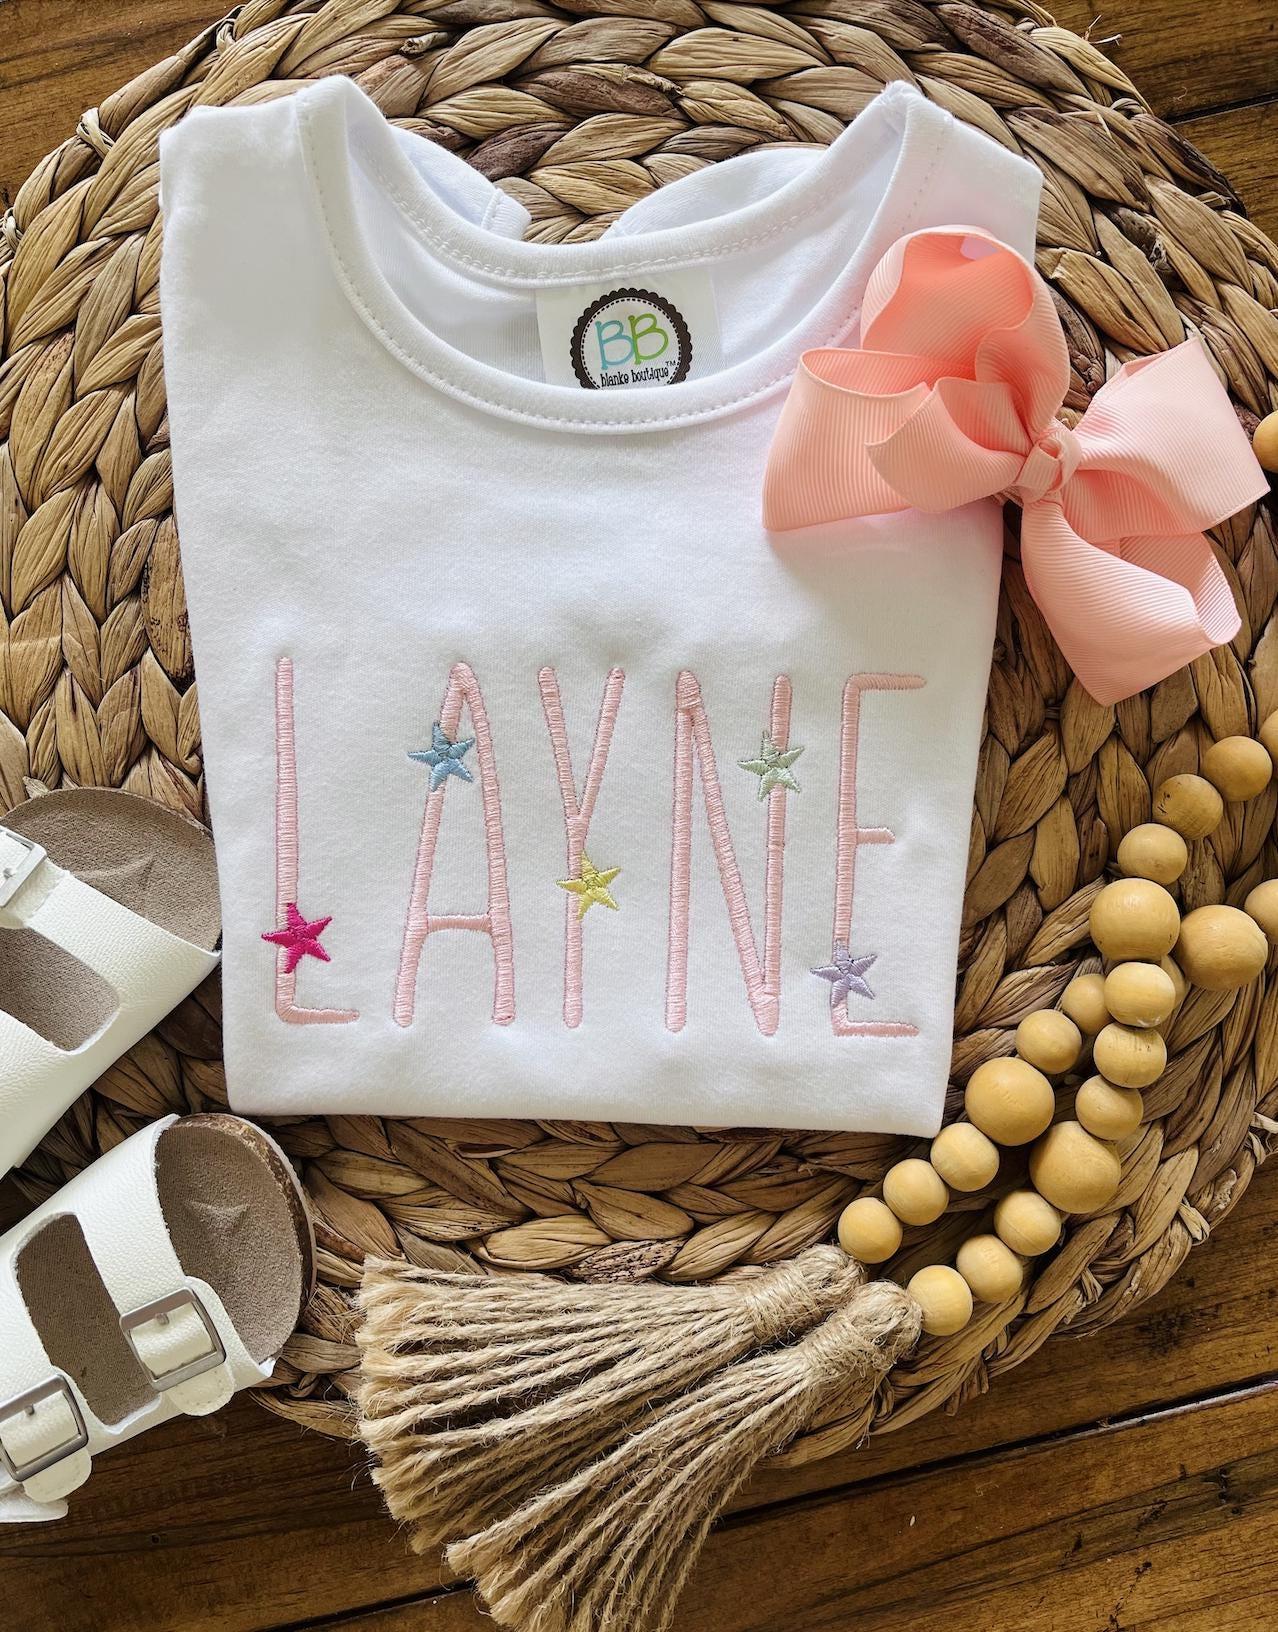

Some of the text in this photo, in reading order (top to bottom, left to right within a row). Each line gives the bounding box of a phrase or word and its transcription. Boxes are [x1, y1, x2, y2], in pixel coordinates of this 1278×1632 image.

[595, 313, 669, 370] BB
[600, 371, 630, 388] blanke
[275, 656, 927, 1037] LAYNE
